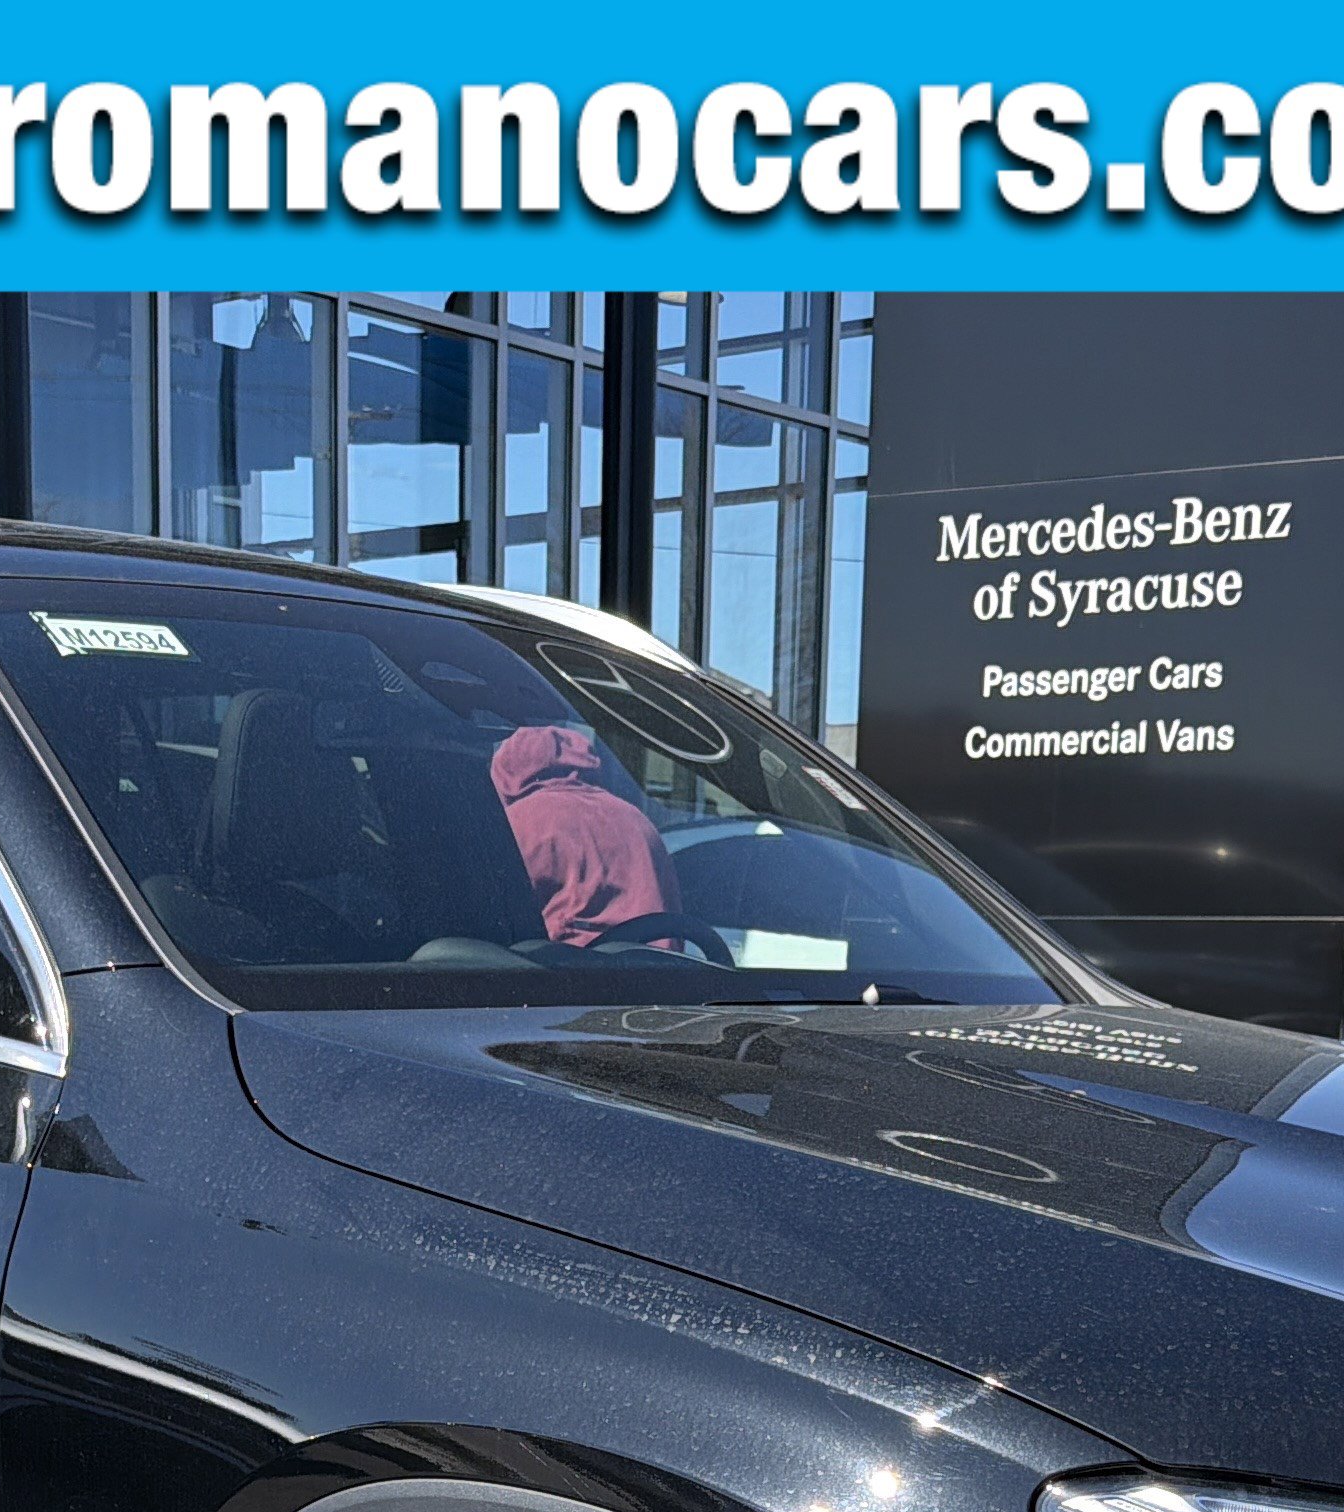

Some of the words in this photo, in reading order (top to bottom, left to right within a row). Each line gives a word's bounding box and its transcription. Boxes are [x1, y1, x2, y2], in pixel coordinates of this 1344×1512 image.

[936, 497, 1292, 562] Mercedes-Benz
[973, 571, 1020, 621] of
[1028, 569, 1243, 628] Syracuse
[59, 627, 176, 651] M12594
[982, 664, 1142, 702] Passenger
[1148, 656, 1223, 691] Cars
[964, 720, 1147, 759] Commercial
[1156, 718, 1235, 753] Vans
